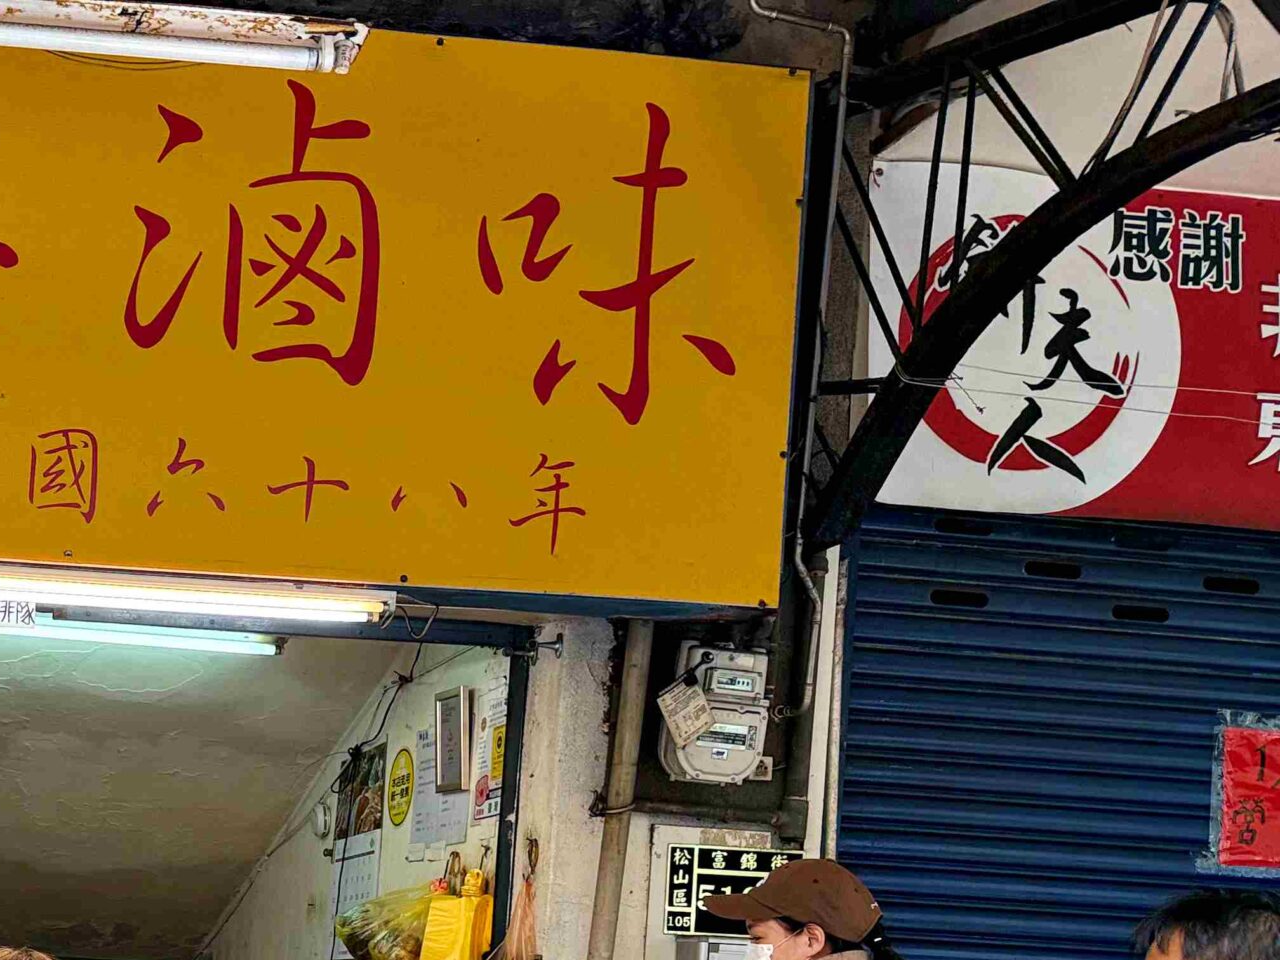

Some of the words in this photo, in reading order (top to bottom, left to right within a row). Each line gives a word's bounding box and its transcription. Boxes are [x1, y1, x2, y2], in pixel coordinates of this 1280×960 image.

[1109, 208, 1245, 292] 感謝
[672, 848, 692, 907] 松山區
[668, 916, 690, 927] 105
